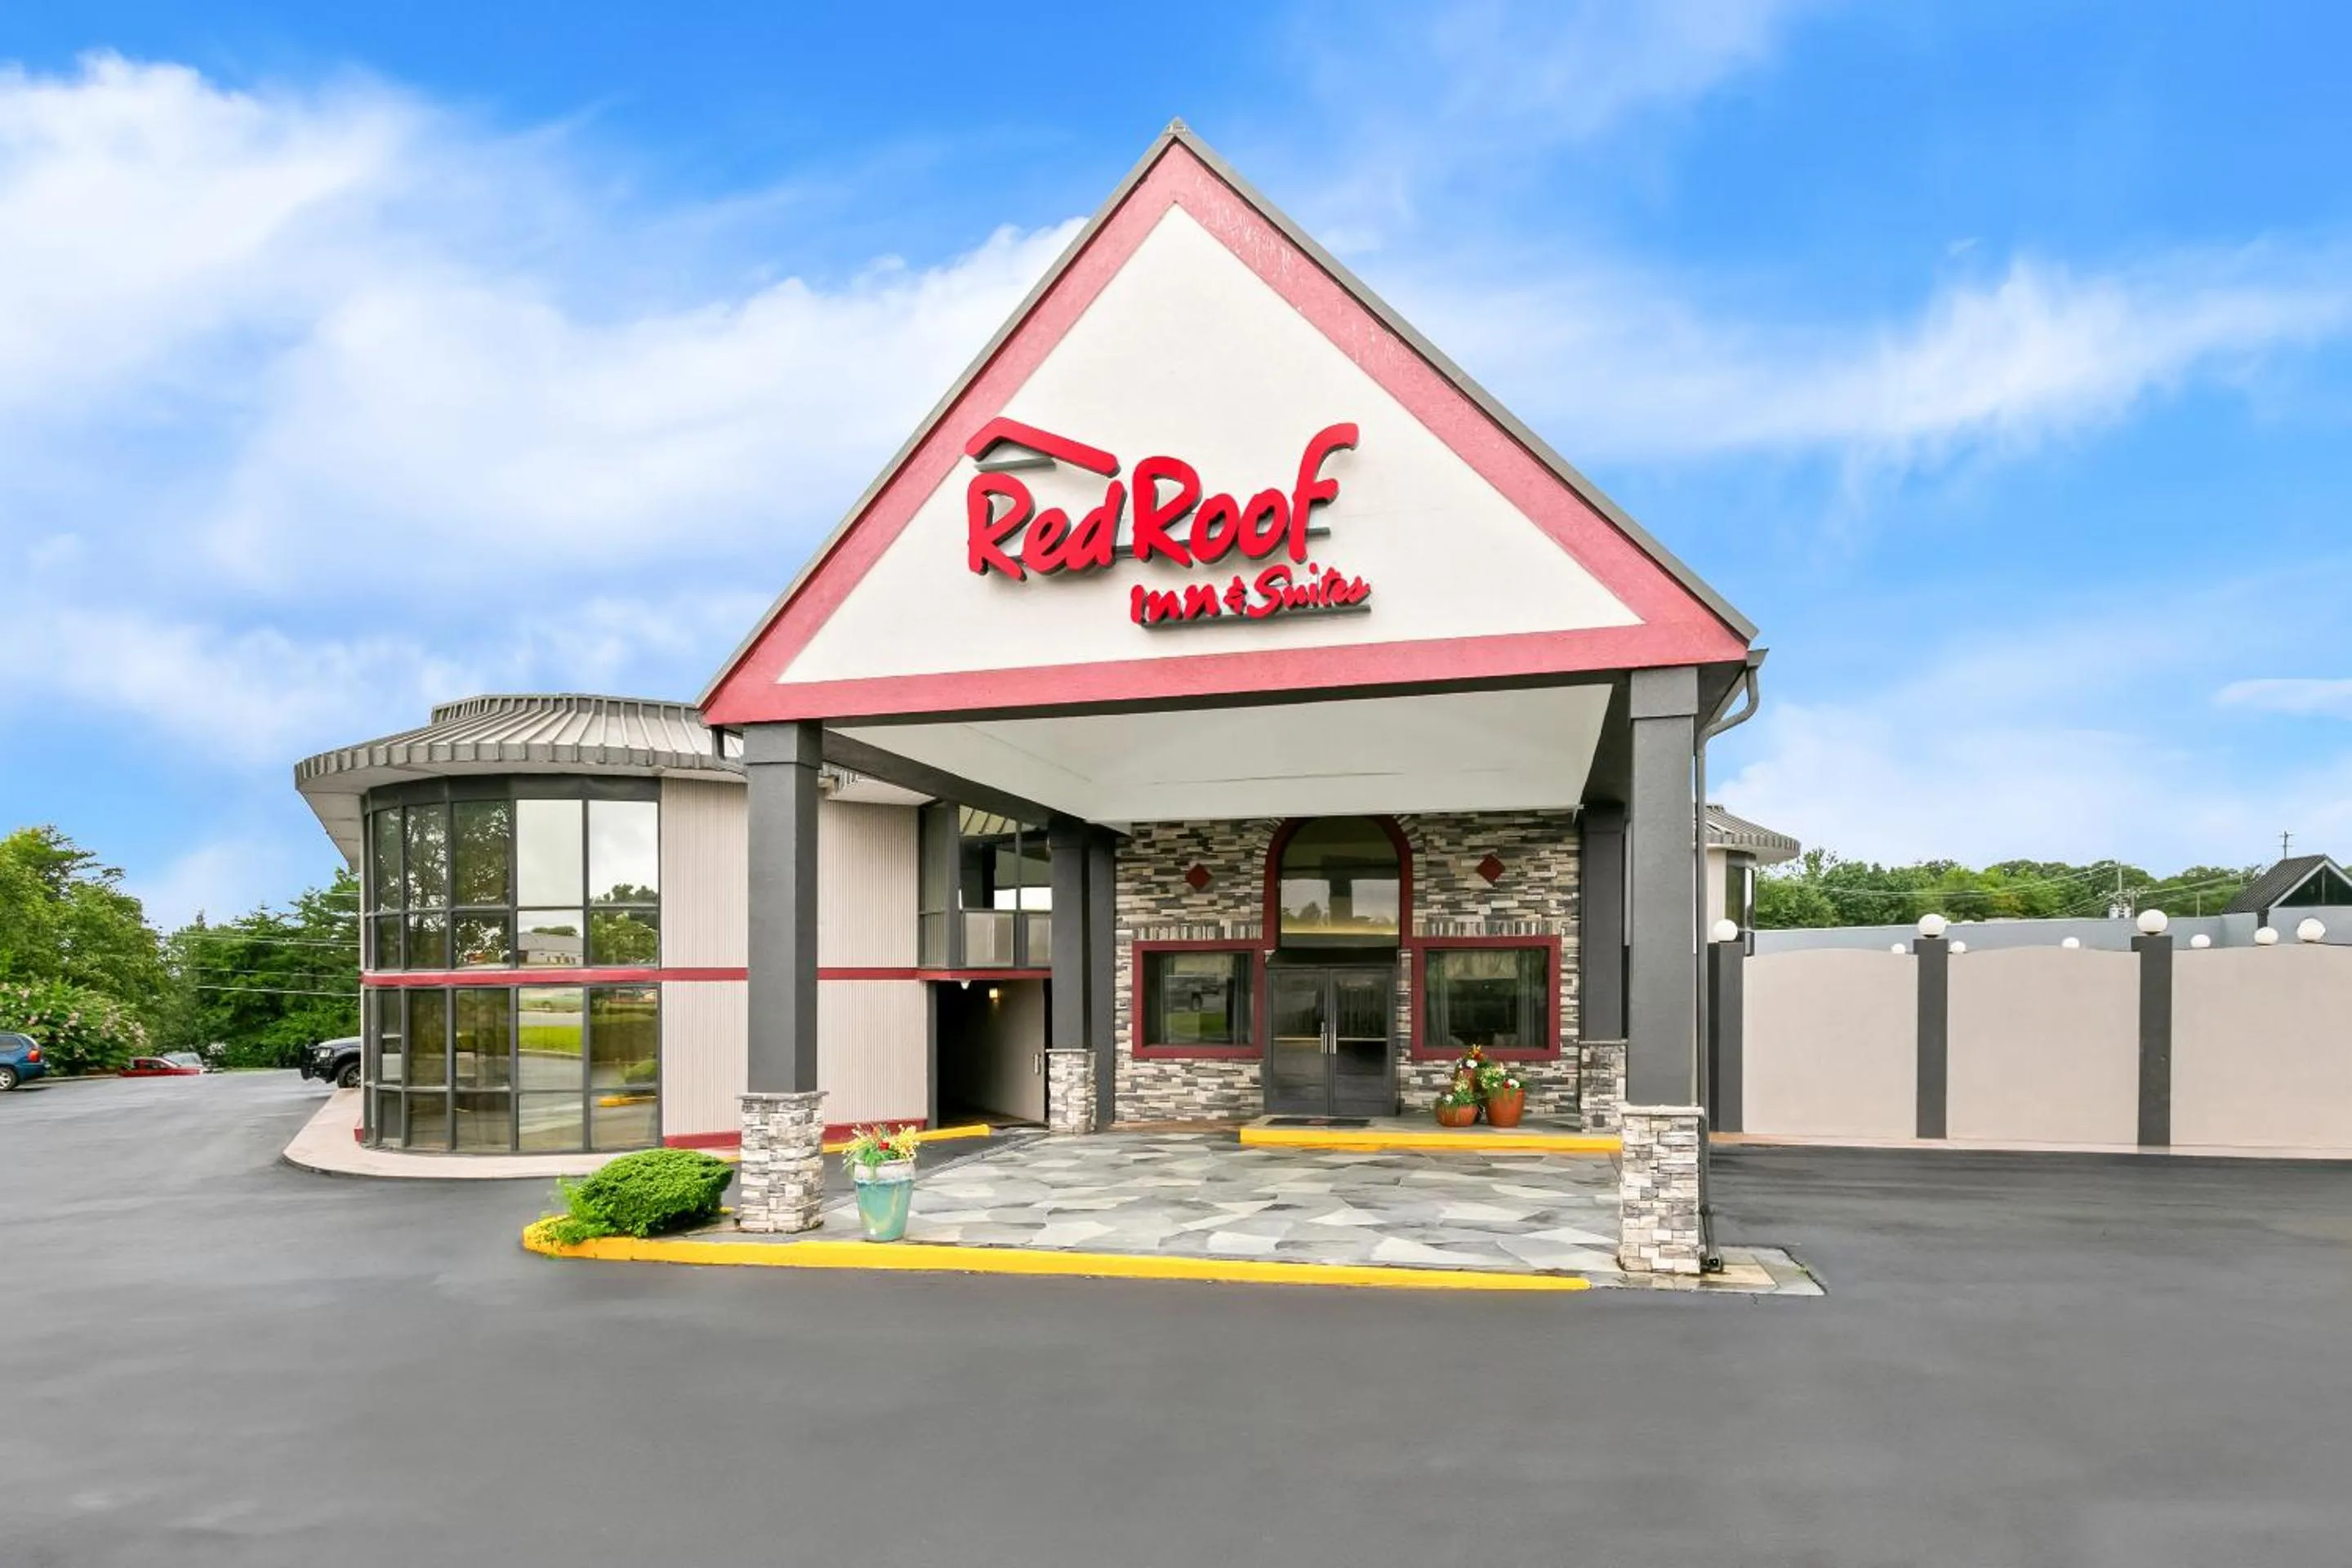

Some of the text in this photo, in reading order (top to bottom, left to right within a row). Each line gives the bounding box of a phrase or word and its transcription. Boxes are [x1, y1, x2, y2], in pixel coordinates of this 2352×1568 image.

[967, 422, 1359, 581] Red Roof
[1247, 562, 1371, 619] Suites
